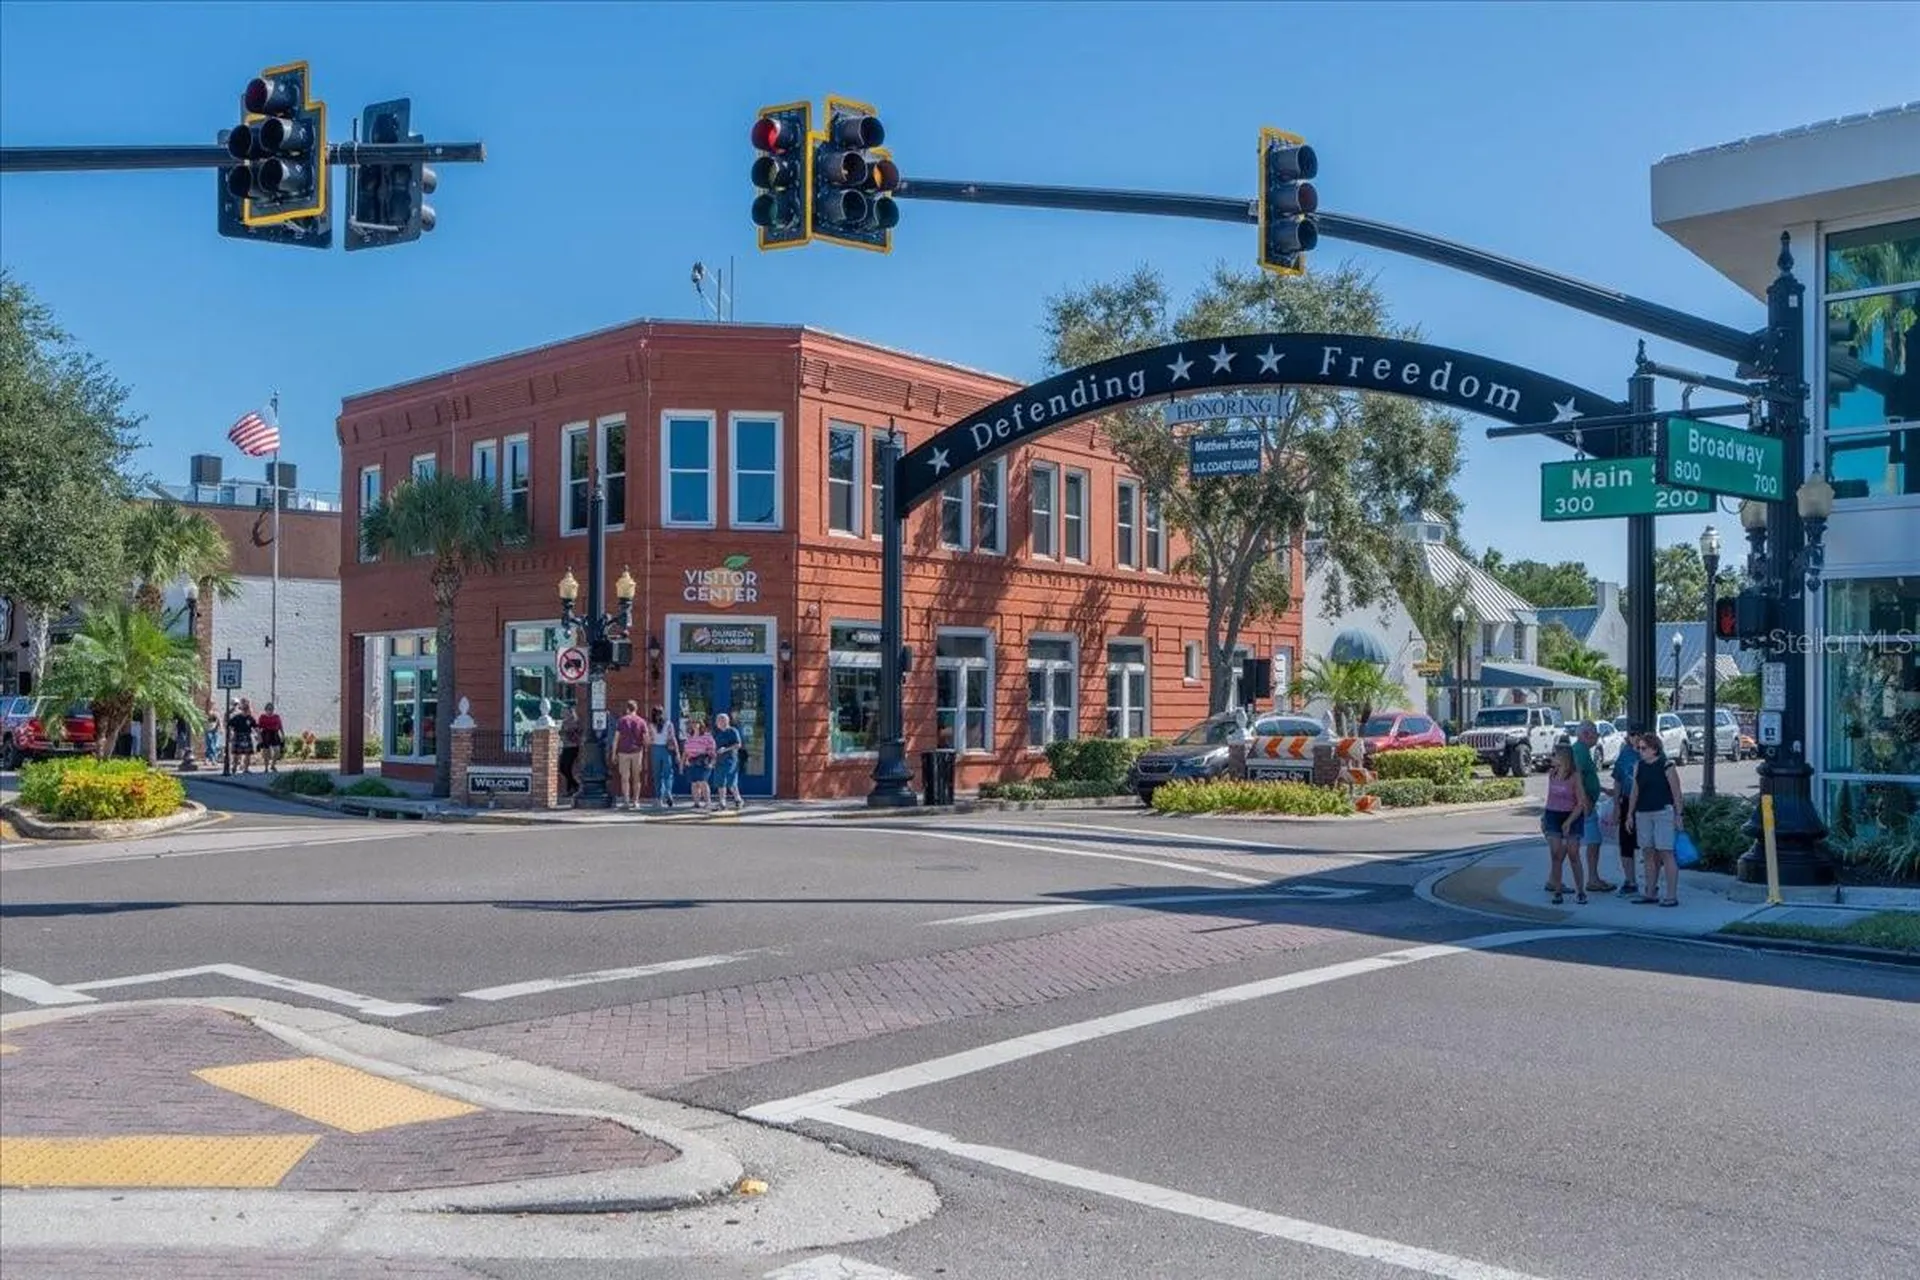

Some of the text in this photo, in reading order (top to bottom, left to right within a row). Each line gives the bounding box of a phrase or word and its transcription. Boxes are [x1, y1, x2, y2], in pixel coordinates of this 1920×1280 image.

[969, 346, 1522, 450] Defending Freedom
[1176, 398, 1271, 419] HONORING
[1194, 440, 1229, 452] Matthew
[1687, 428, 1766, 471] Broadway
[1207, 461, 1231, 472] COAST
[1232, 459, 1259, 471] GUARD
[1572, 466, 1633, 490] Main
[1674, 459, 1701, 482] 800
[1753, 473, 1778, 495] 700
[1554, 490, 1699, 514] 300 200
[684, 569, 757, 586] VISITOR
[683, 586, 758, 603] CENTER
[223, 675, 236, 685] 15
[474, 778, 526, 788] WELCOME
